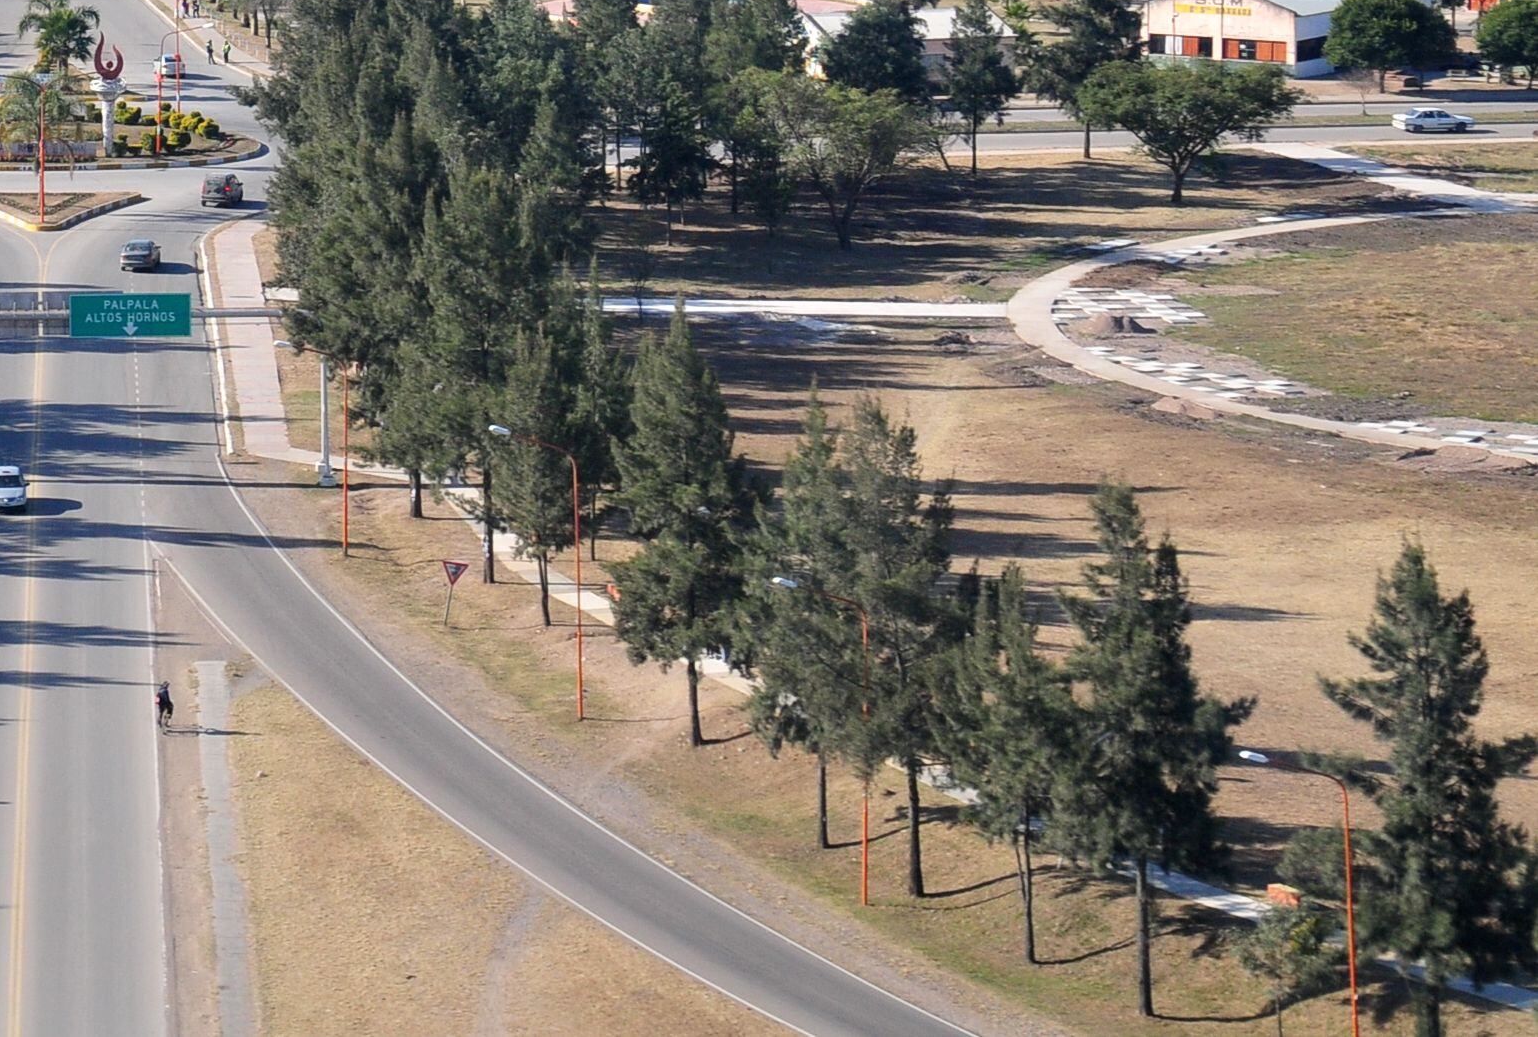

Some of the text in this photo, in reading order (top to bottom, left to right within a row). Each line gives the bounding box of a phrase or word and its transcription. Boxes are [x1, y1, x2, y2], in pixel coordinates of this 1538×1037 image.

[103, 300, 159, 310] PALPALA
[85, 311, 176, 323] ALTOS HORNOS
